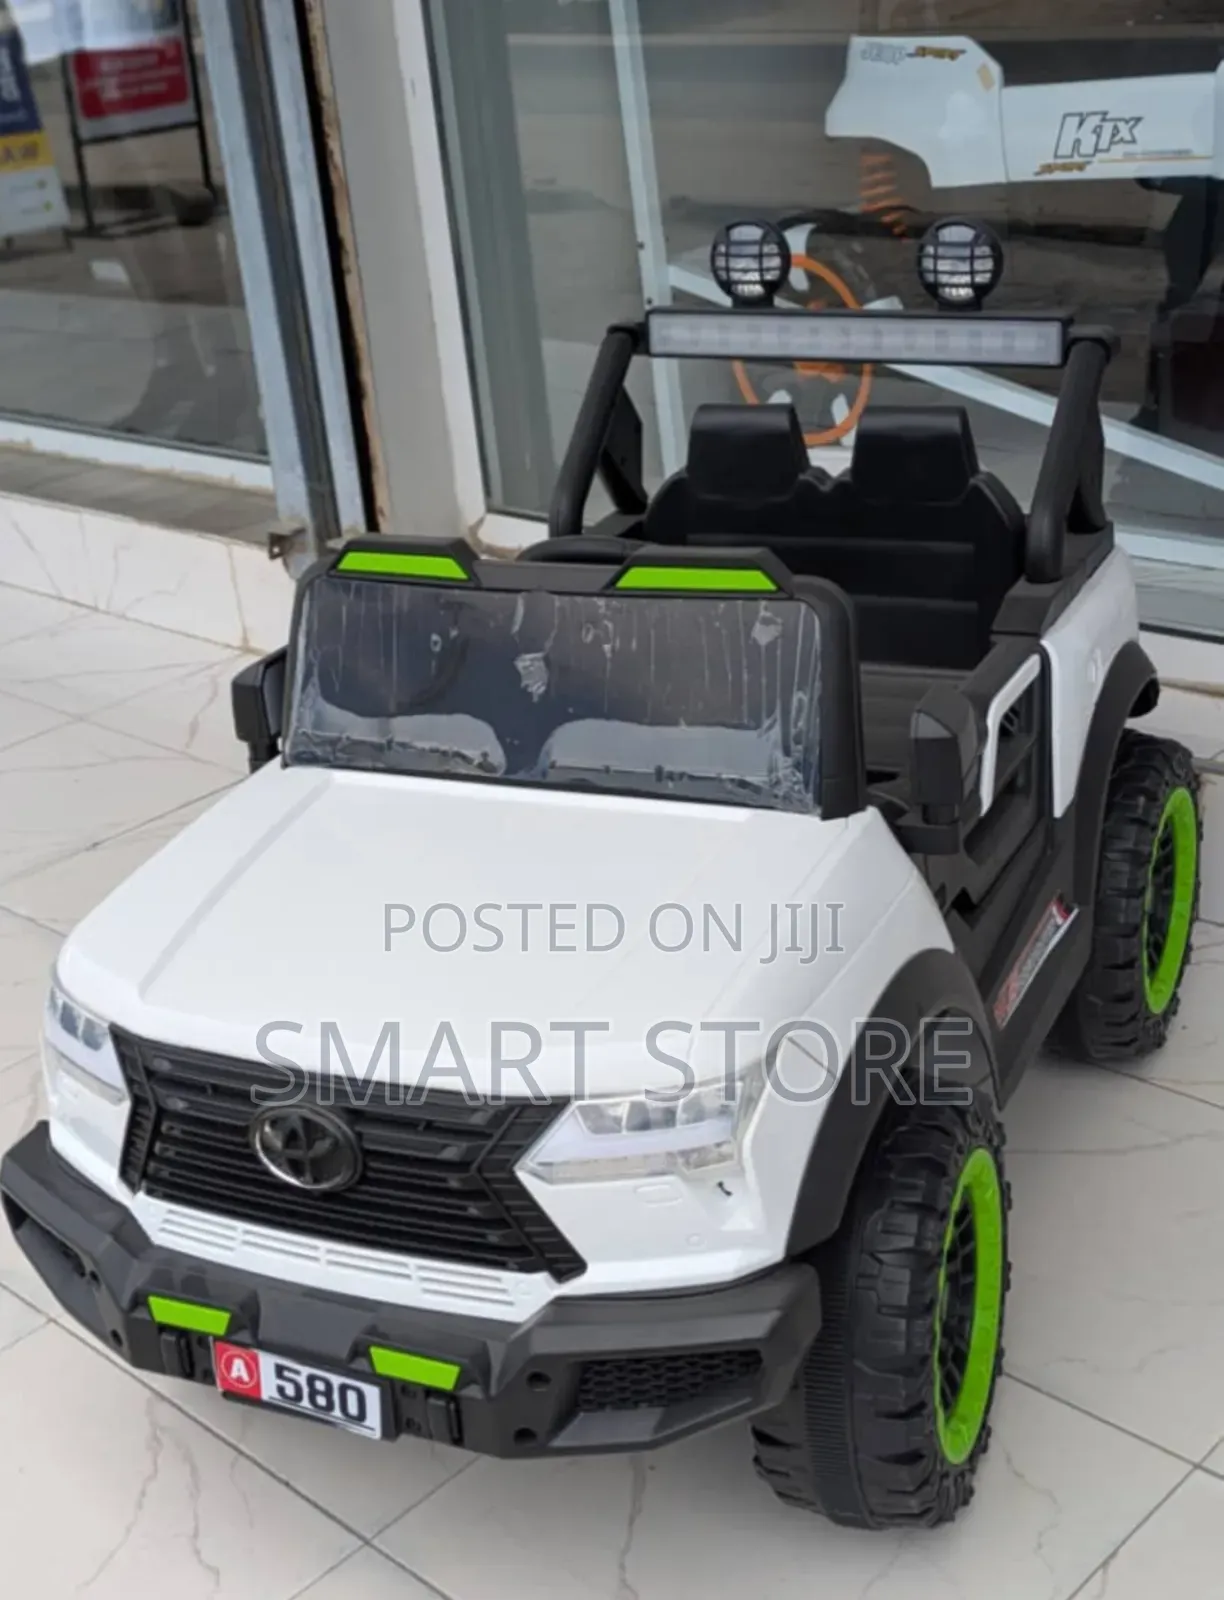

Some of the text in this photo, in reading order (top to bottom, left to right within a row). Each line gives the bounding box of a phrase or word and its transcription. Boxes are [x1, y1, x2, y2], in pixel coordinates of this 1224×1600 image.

[1053, 110, 1144, 159] KTX
[230, 1358, 367, 1424] A 580
